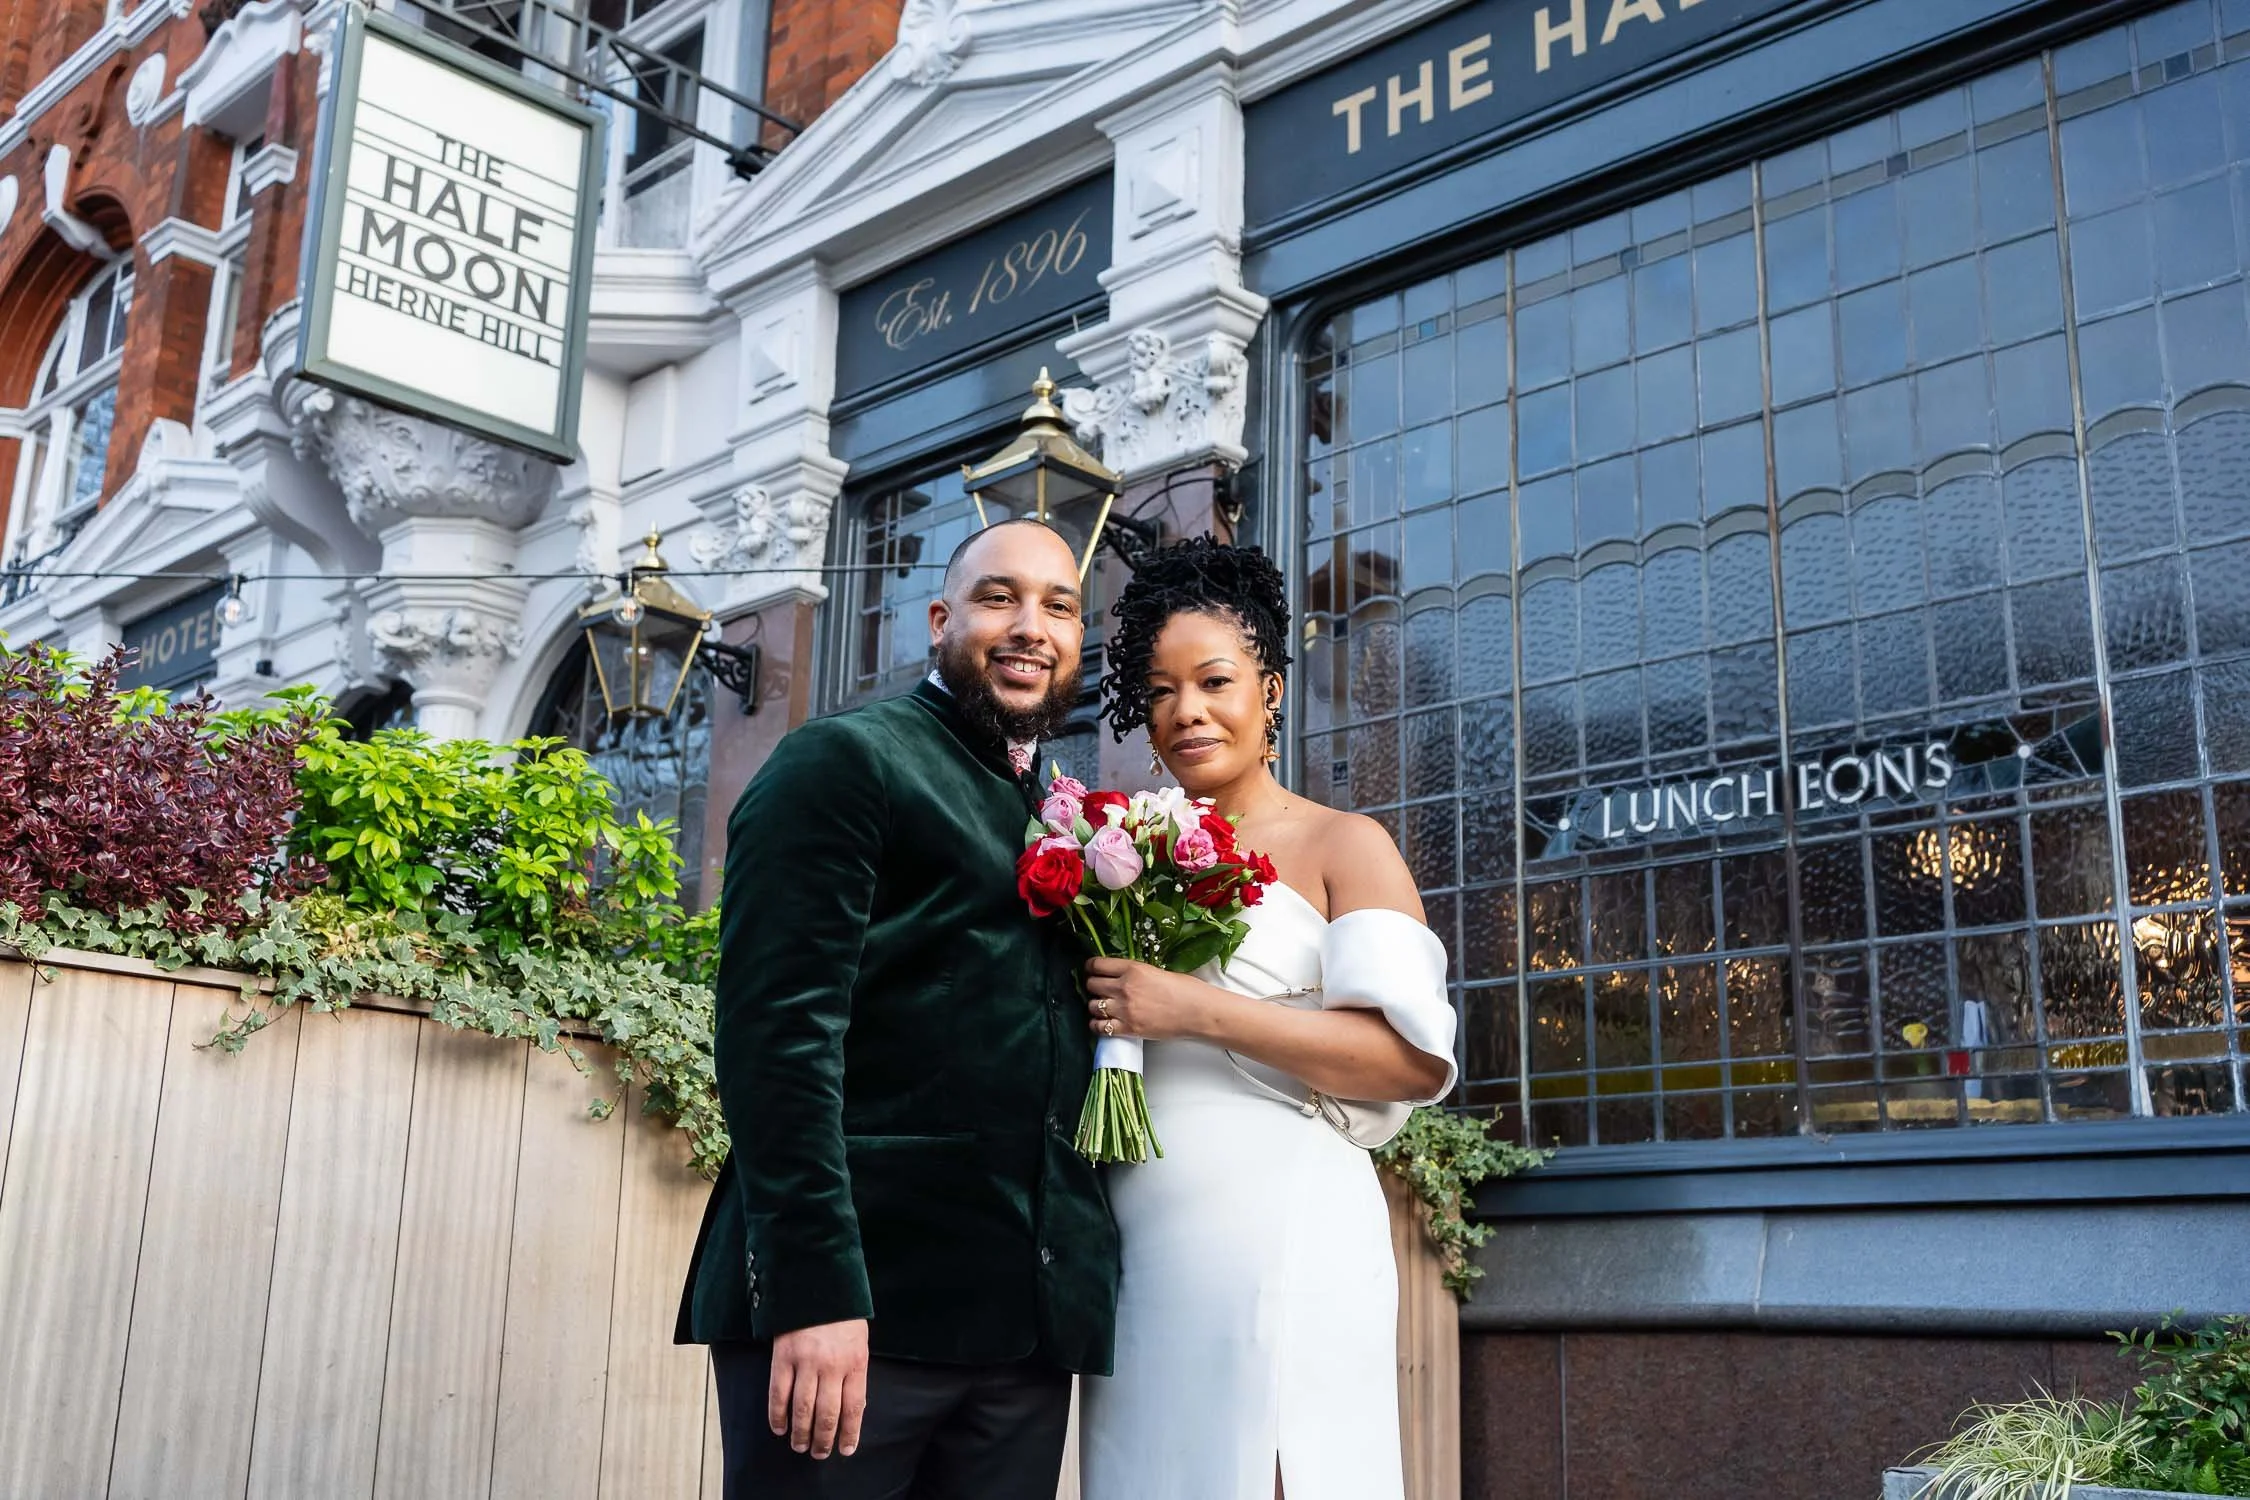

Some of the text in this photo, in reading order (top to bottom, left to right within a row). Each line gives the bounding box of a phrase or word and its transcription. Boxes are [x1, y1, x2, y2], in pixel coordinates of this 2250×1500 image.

[1332, 0, 1707, 154] THE HA
[383, 154, 544, 254] HALF
[436, 133, 507, 188] THE
[348, 264, 551, 366] HERNE HILL
[359, 208, 551, 324] MOON
[875, 206, 1092, 350] Est. 1896
